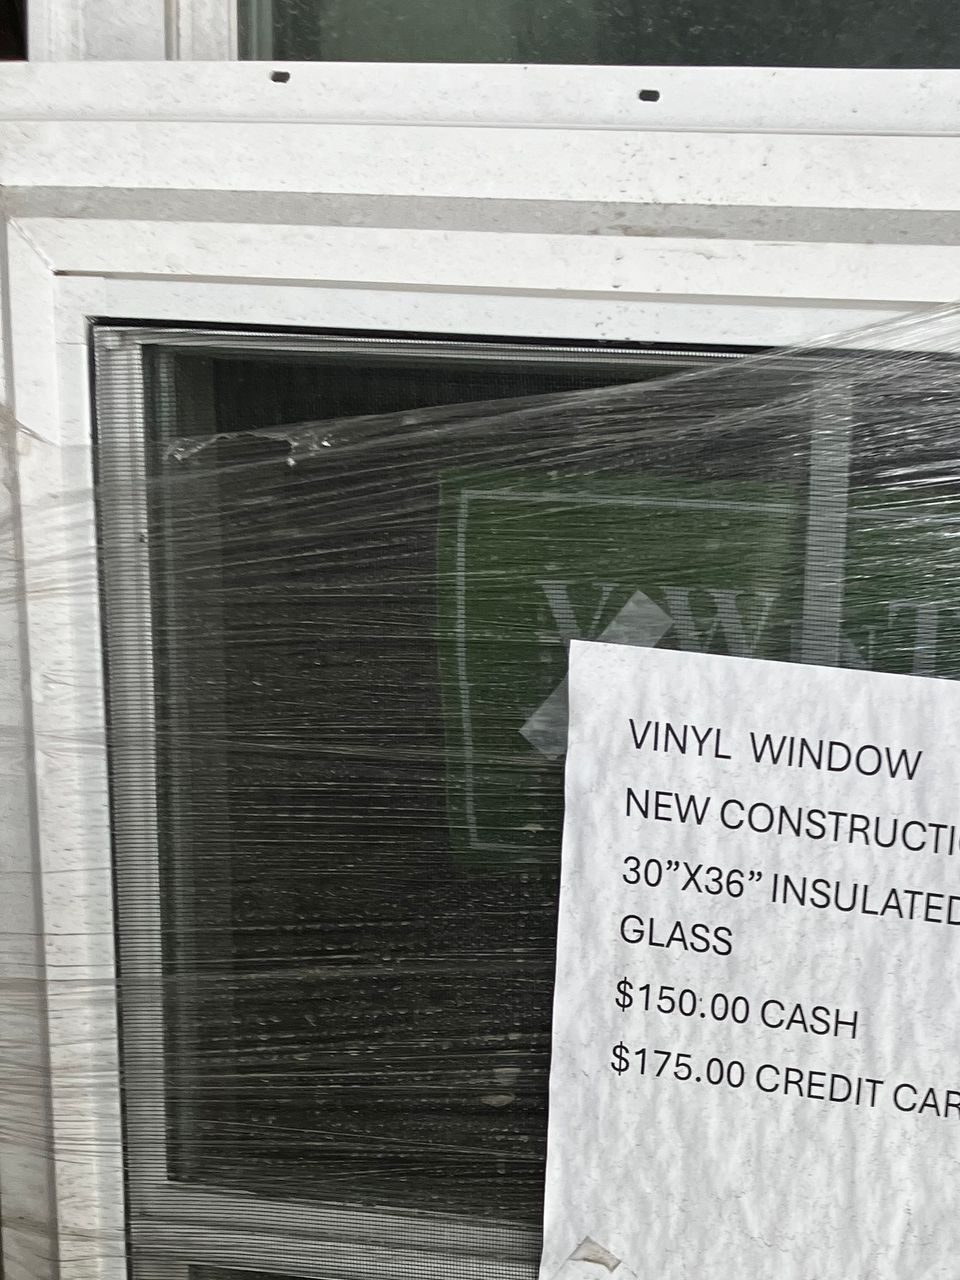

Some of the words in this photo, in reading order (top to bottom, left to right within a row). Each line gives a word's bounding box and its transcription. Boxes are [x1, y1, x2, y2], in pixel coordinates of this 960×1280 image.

[629, 718, 732, 760] VINYL
[750, 732, 923, 781] WINDOW
[626, 787, 711, 825] NEW
[622, 855, 763, 898] 30”X36”
[620, 914, 733, 956] GLASS
[615, 976, 750, 1024] $150.00
[760, 999, 858, 1039] CASH
[610, 1040, 745, 1088] $175.00
[756, 1064, 884, 1108] CREDIT
